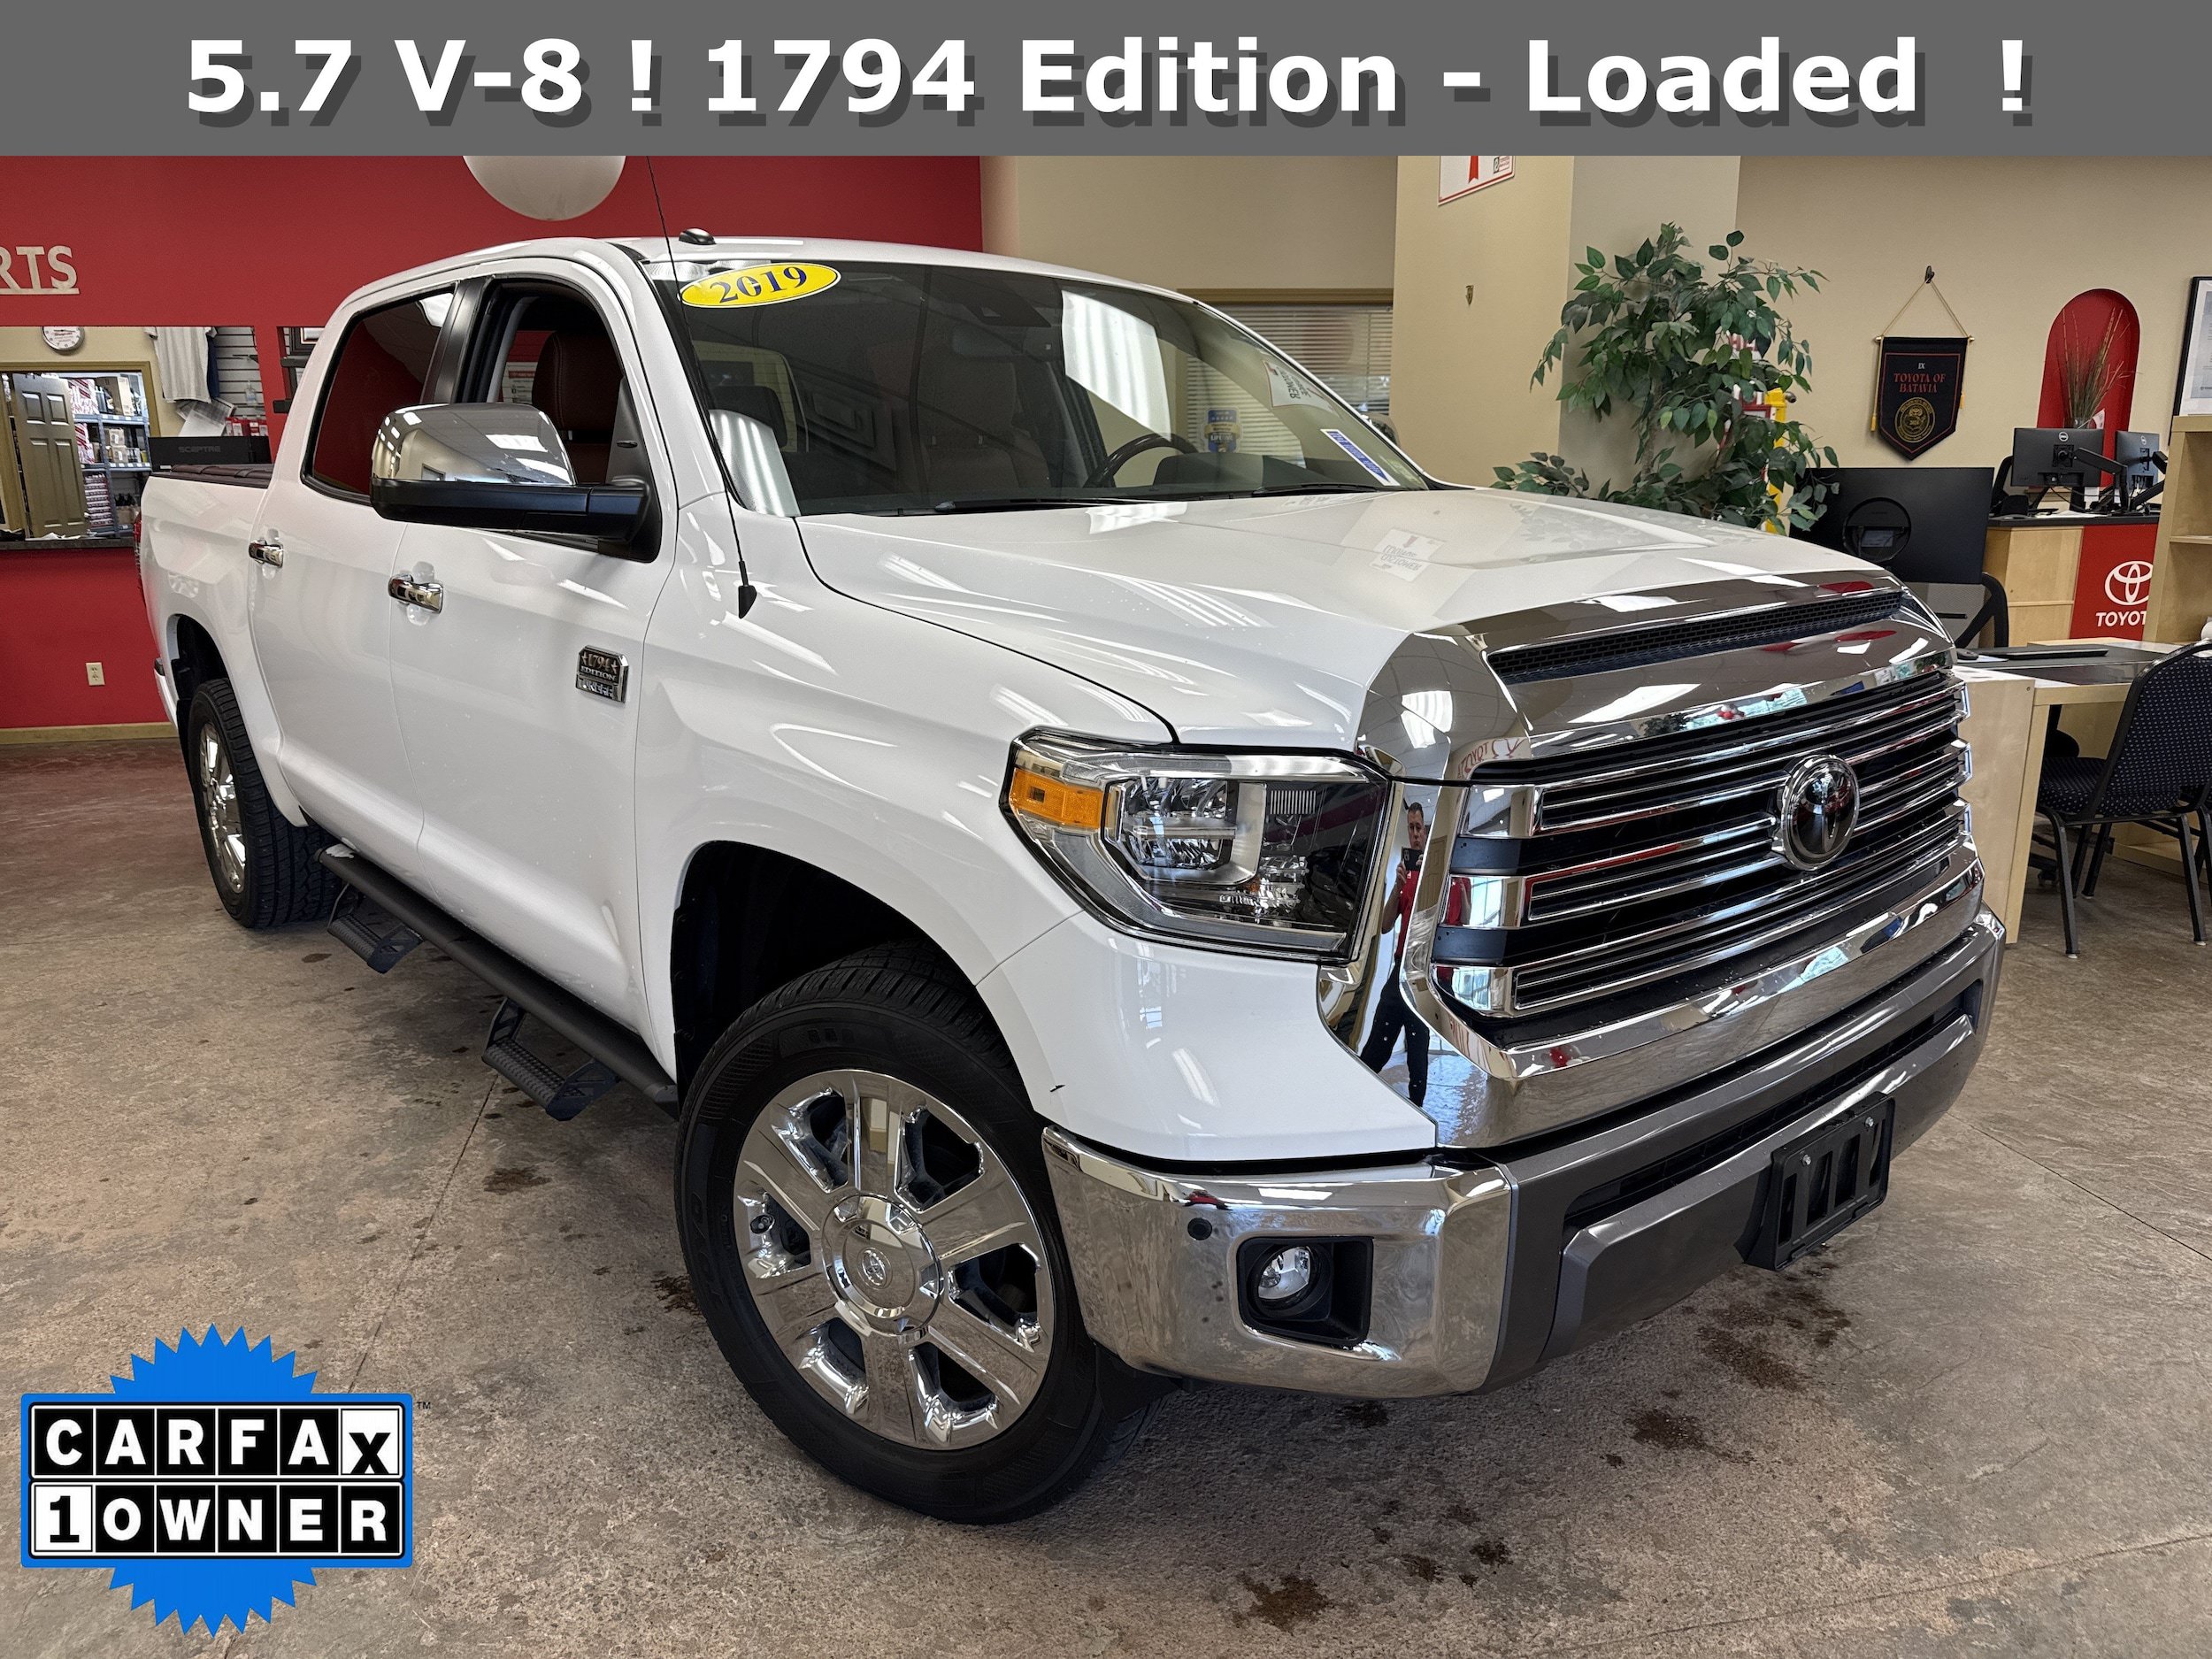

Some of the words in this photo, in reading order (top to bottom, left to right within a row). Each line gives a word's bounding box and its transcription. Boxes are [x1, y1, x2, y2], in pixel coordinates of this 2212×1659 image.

[710, 266, 807, 303] 2019
[1894, 373, 1930, 383] TOYOTA
[1932, 373, 1947, 383] OF
[1899, 383, 1938, 393] BATAVIA
[588, 654, 611, 671] 1794
[580, 665, 617, 681] EDITION
